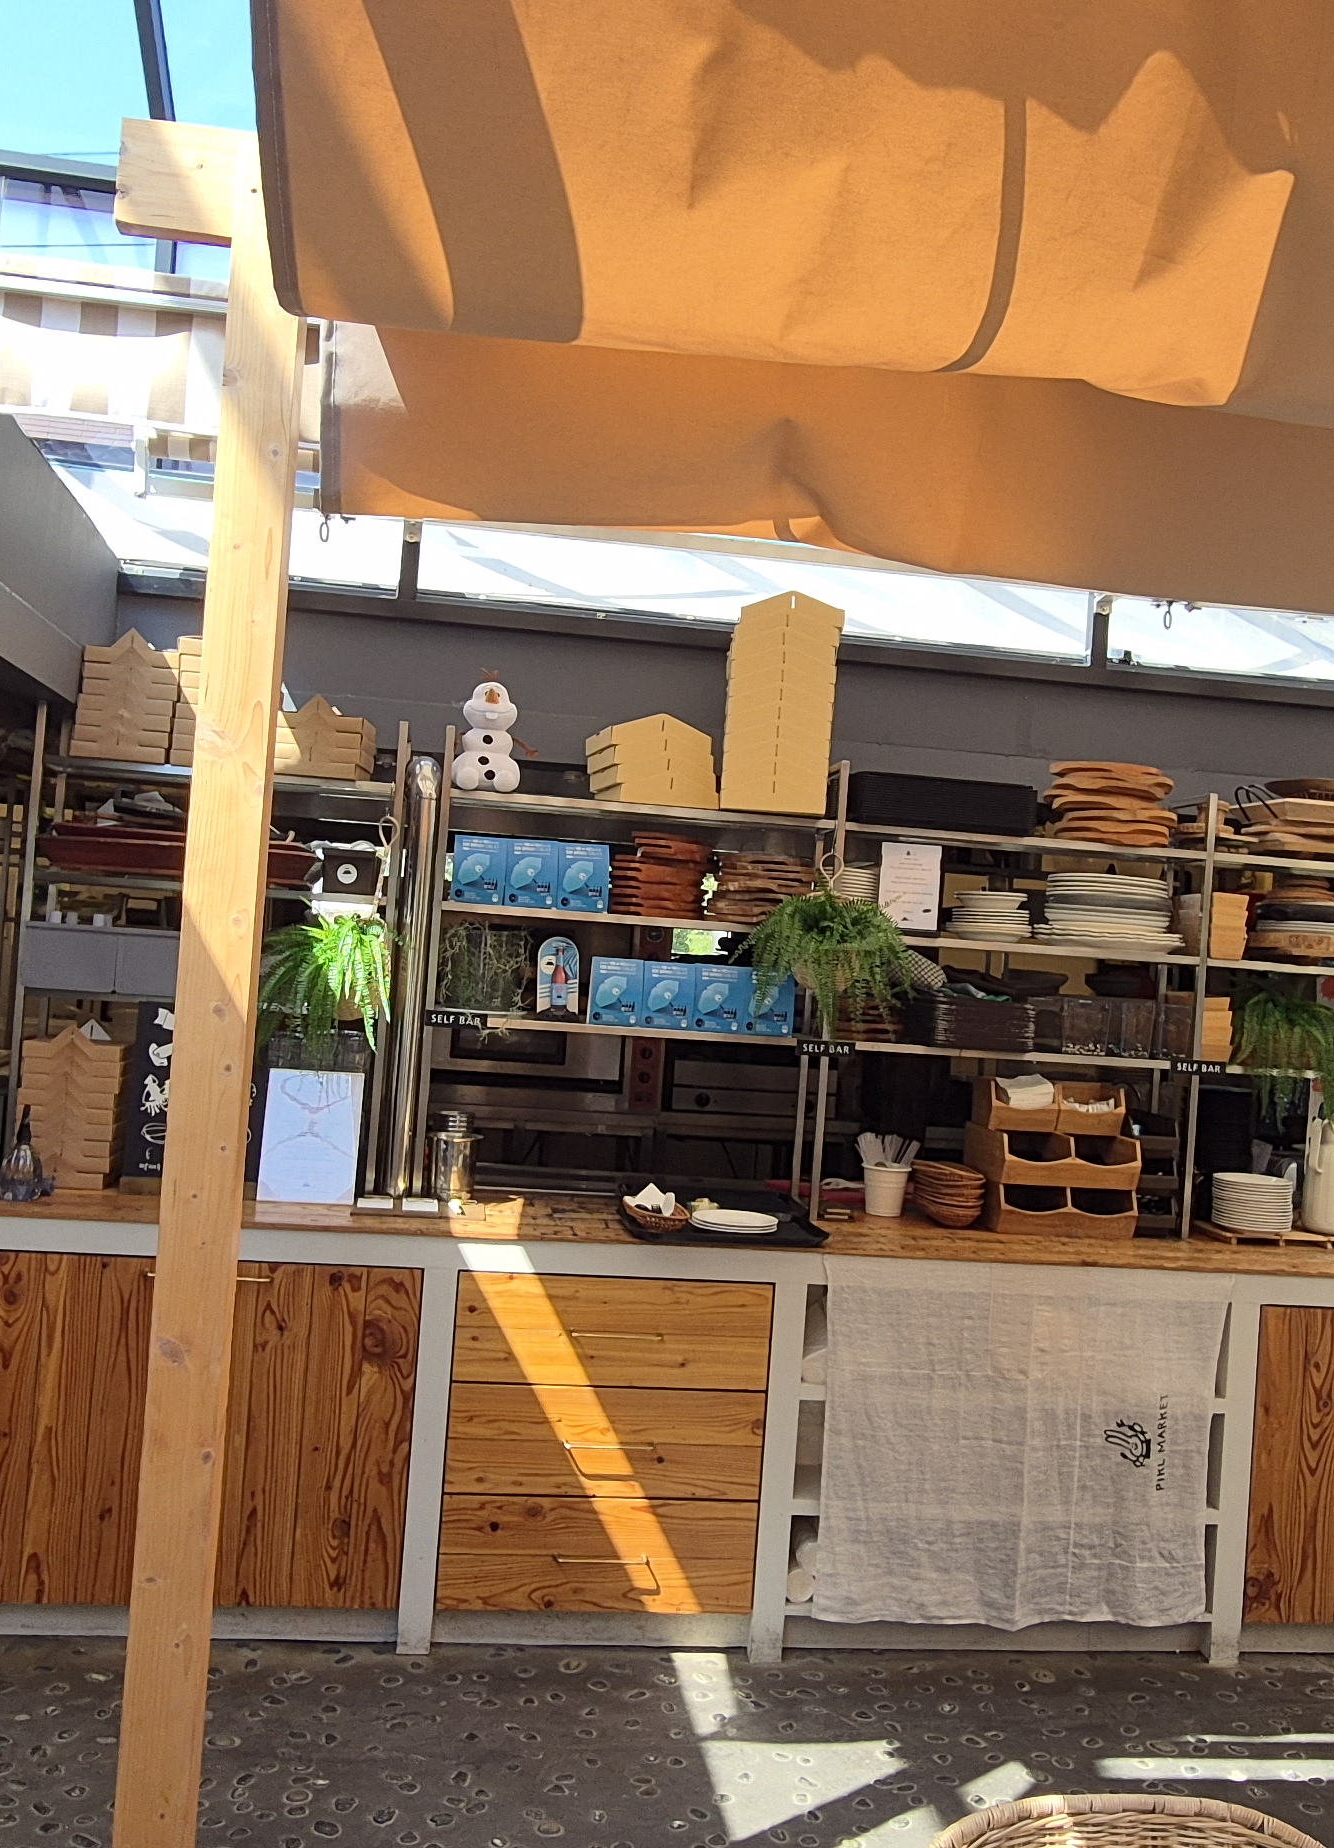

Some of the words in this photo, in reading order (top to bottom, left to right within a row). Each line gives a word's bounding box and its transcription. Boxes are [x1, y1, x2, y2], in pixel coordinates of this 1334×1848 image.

[431, 1013, 455, 1024] SELF
[458, 1015, 481, 1026] BAR
[802, 1043, 825, 1053] SELF
[829, 1045, 849, 1055] BAR
[1177, 1062, 1198, 1072] SELF
[1201, 1063, 1221, 1074] BAR
[1157, 1394, 1168, 1453] MARKET
[1155, 1458, 1165, 1491] PIKL
